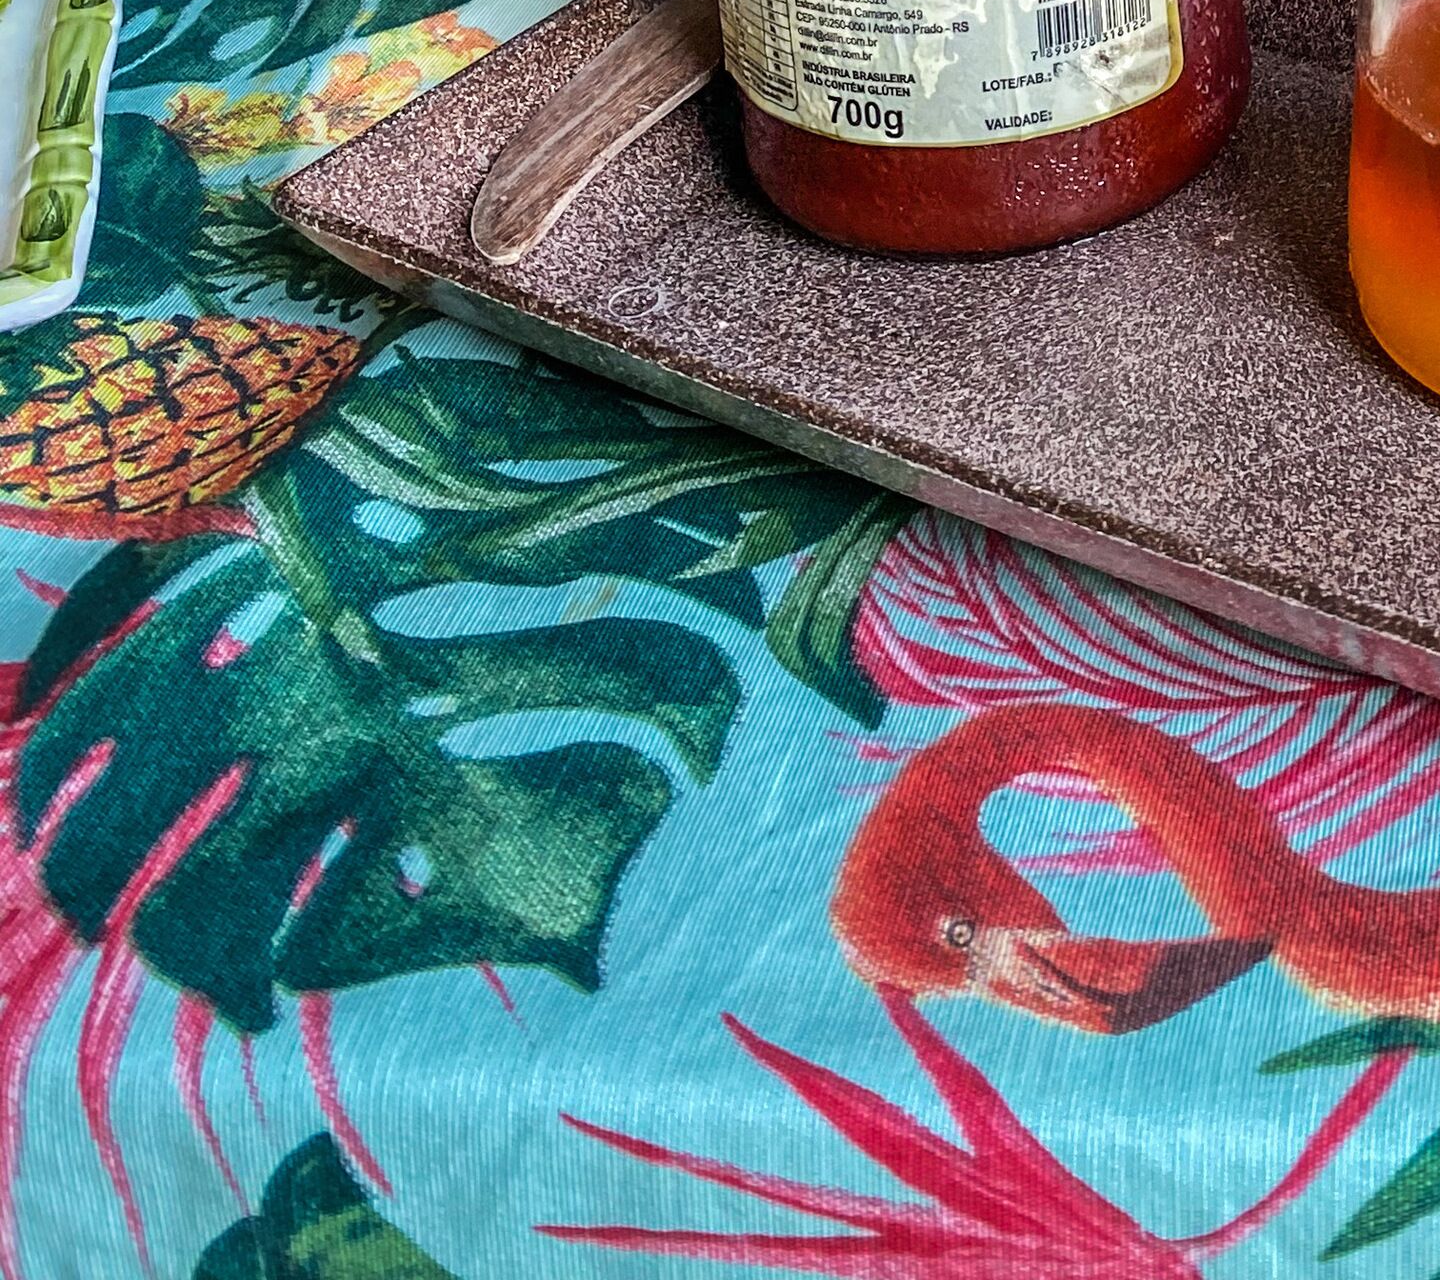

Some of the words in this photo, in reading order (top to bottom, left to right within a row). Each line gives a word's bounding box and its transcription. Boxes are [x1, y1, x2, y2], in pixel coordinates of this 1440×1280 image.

[828, 3, 852, 17] Linha
[904, 10, 923, 20] 549
[873, 23, 910, 35] Antônio
[912, 23, 943, 35] Prado
[952, 21, 970, 33] RS
[802, 60, 851, 79] INDÚSTRIA
[852, 70, 916, 85] BRASILEIRA
[824, 79, 866, 95] CONTÉM
[867, 84, 911, 98] GLÚTEN
[827, 95, 905, 138] 700g
[985, 110, 1053, 131] VALIDADE:
